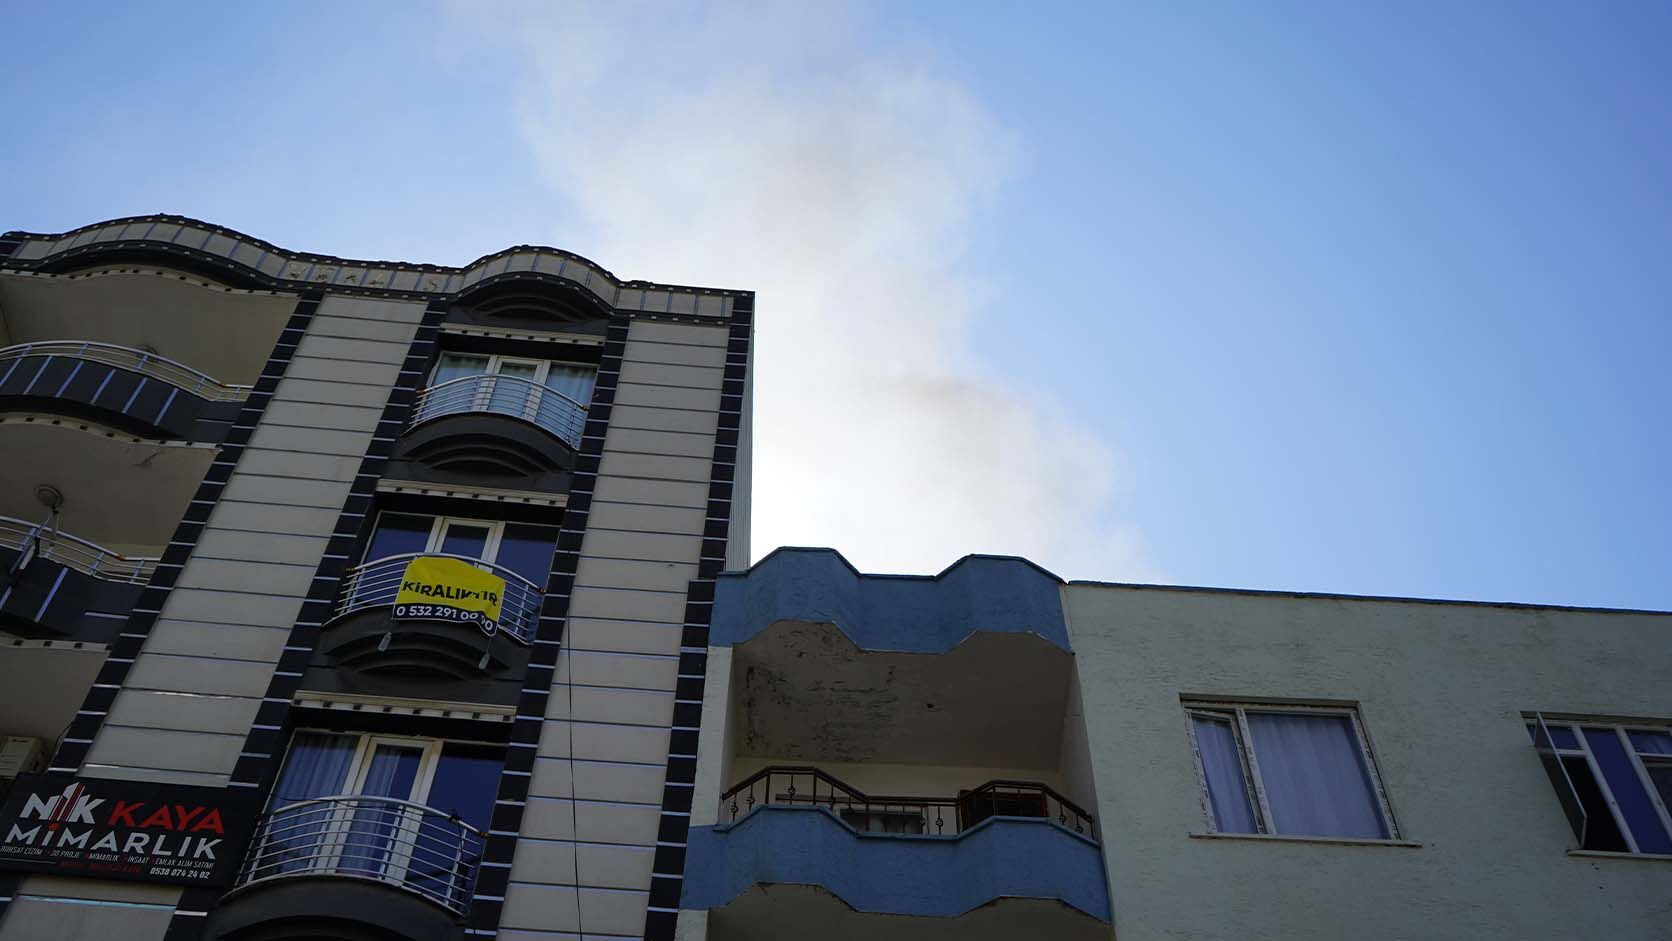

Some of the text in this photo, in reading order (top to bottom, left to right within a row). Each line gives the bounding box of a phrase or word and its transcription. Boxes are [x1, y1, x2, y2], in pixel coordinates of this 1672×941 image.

[396, 606, 405, 616] 0
[408, 605, 432, 616] 532
[434, 606, 457, 618] 291
[108, 800, 224, 833] KAYA
